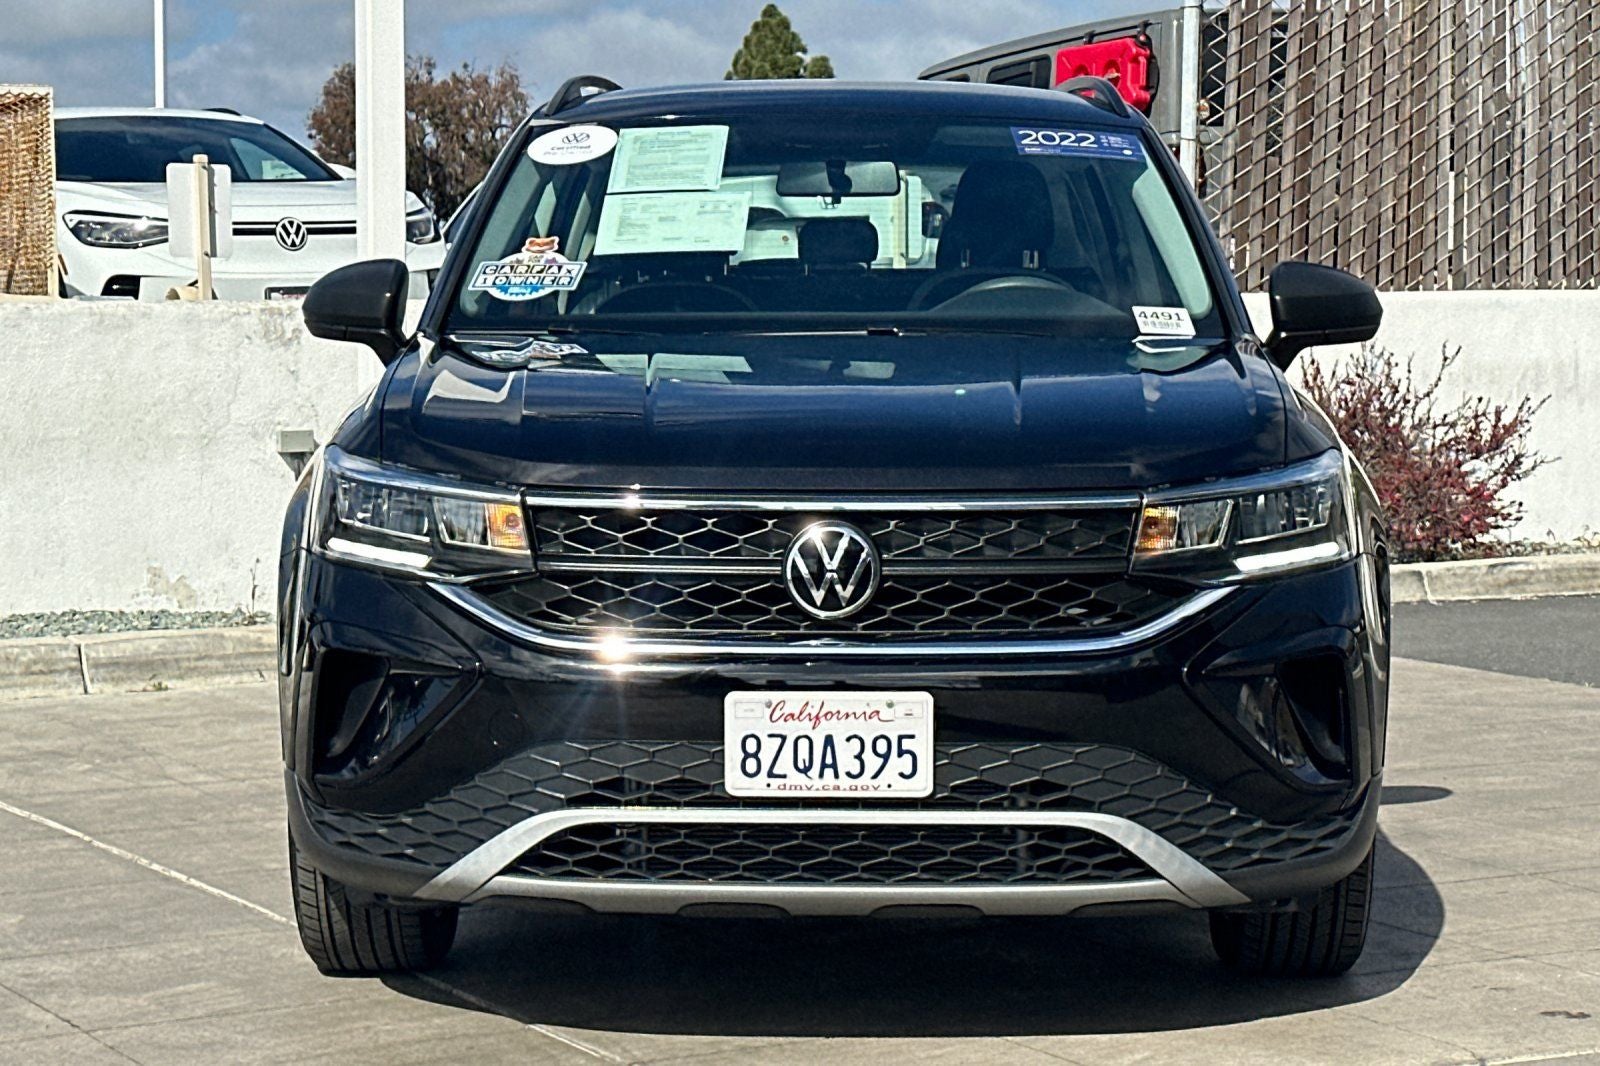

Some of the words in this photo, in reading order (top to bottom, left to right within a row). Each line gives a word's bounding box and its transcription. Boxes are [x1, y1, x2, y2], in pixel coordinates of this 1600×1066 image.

[1018, 129, 1099, 148] 2022
[278, 219, 306, 248] VW
[484, 264, 576, 275] CARFAX
[493, 275, 573, 286] OWNER
[1138, 311, 1185, 322] 4491
[787, 524, 875, 612] VW
[768, 699, 895, 730] California
[739, 732, 919, 780] 8ZQA395
[776, 782, 882, 792] dmv.ca.gov
